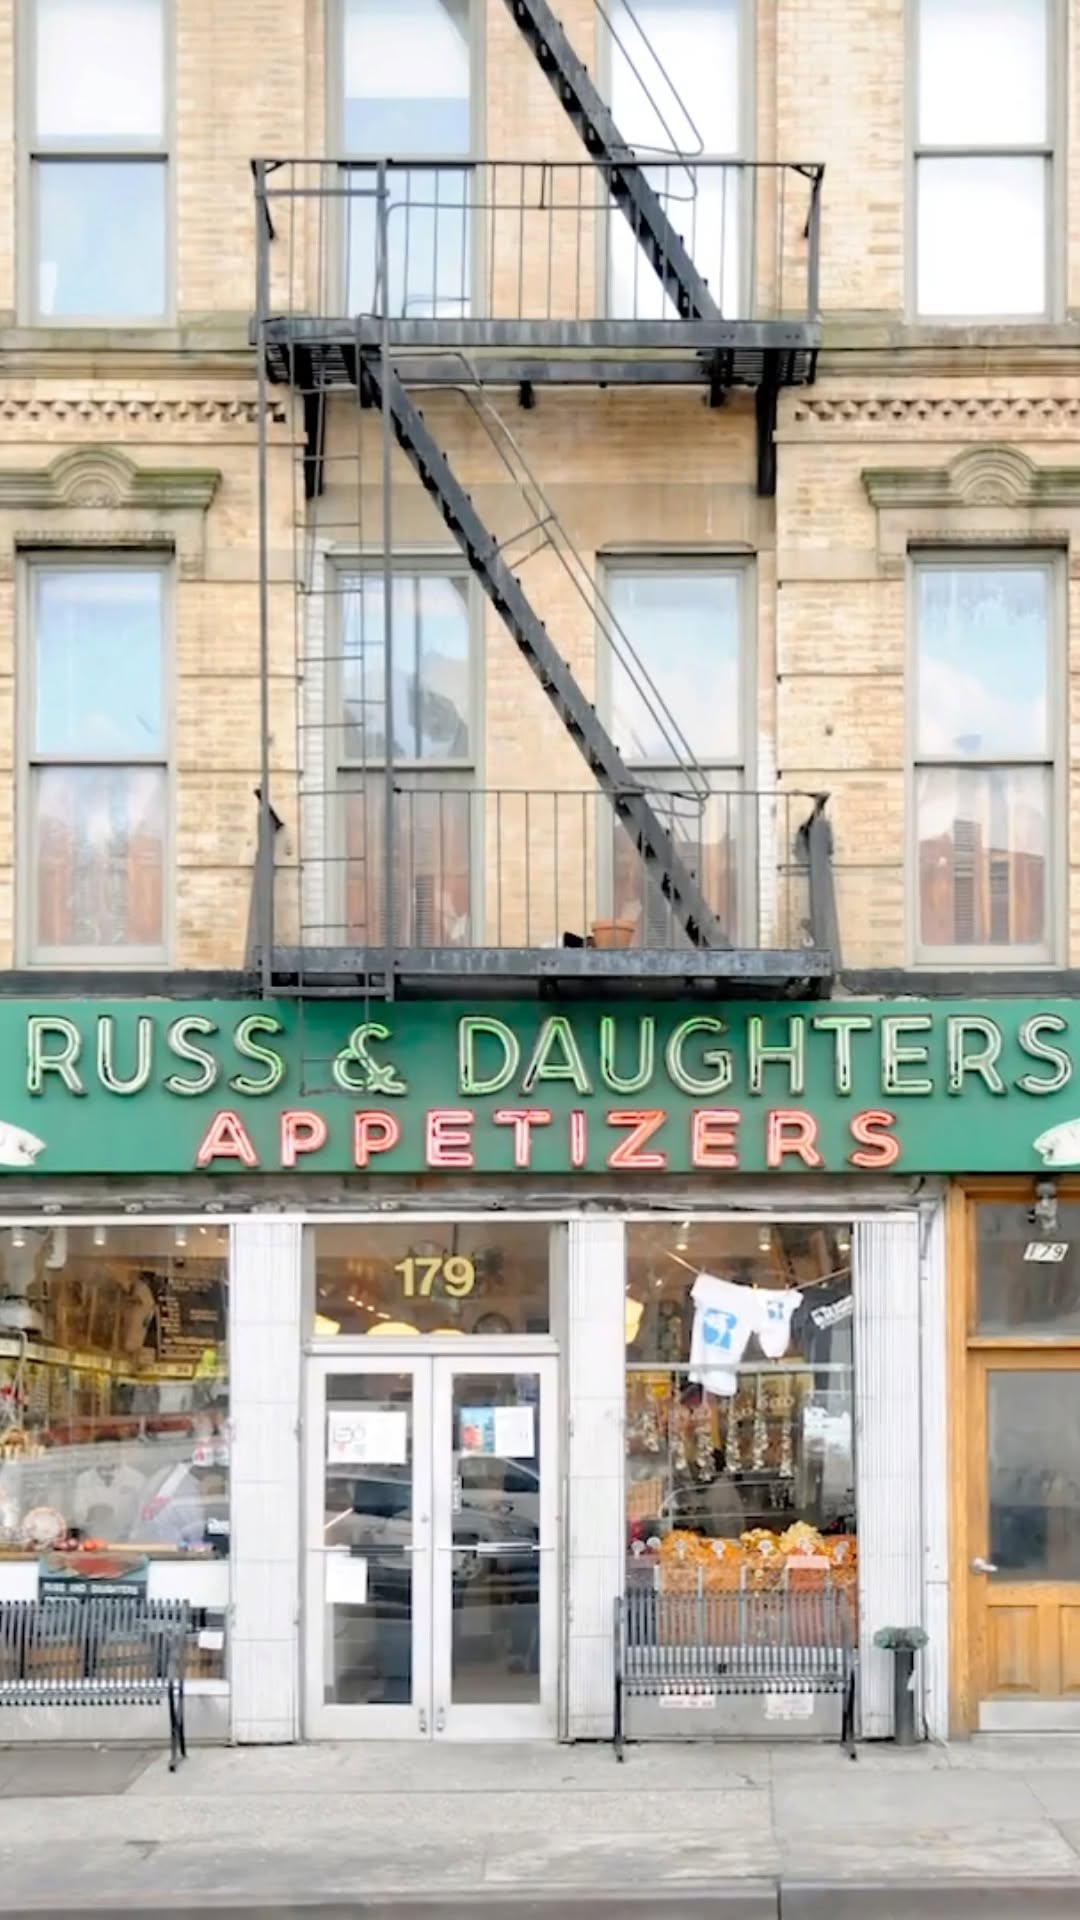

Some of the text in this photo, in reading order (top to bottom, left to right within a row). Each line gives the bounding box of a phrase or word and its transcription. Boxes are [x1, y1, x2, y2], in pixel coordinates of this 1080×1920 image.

[26, 1015, 1077, 1097] RUSS & DAUGHTERS
[196, 1109, 902, 1170] APPETIZERS
[394, 1257, 475, 1298] 179
[1028, 1244, 1064, 1260] 179
